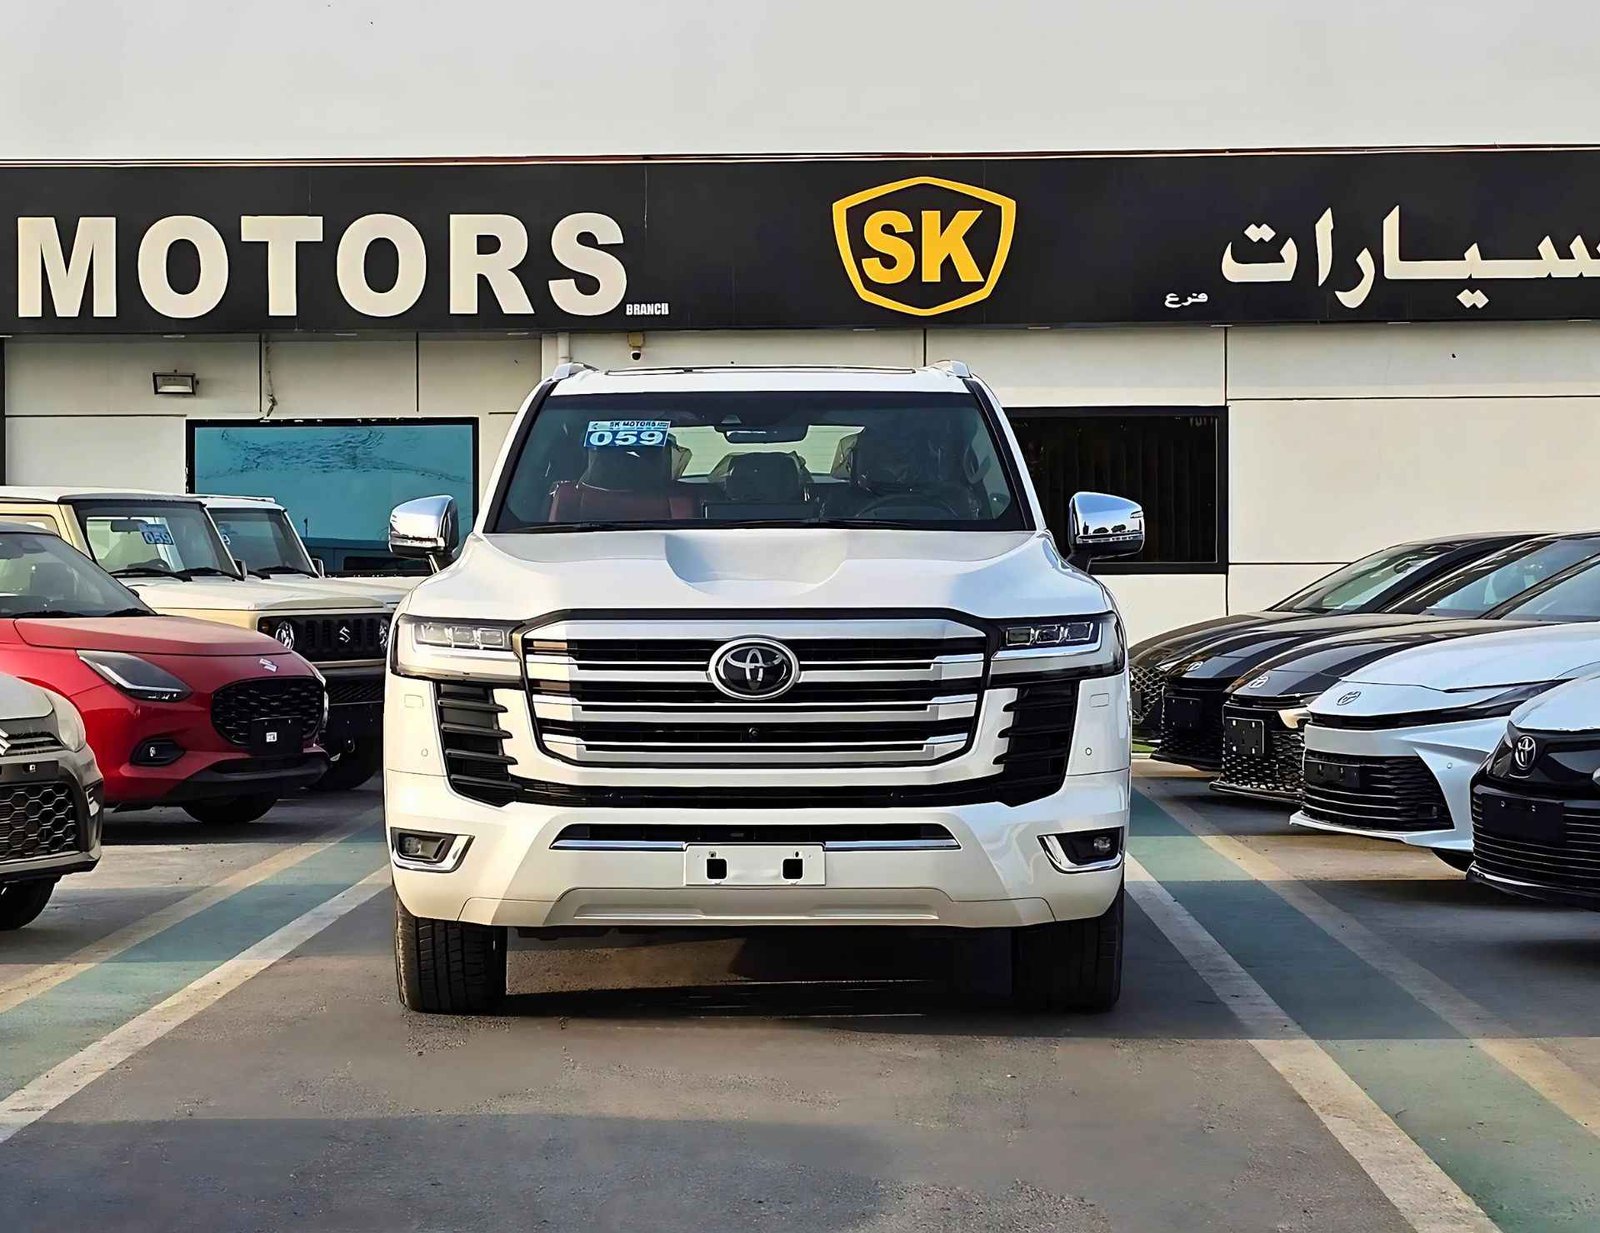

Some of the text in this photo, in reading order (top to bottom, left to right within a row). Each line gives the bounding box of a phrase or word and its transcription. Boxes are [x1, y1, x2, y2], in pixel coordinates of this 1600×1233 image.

[18, 212, 628, 319] MOTORS
[861, 210, 985, 284] SK
[589, 431, 664, 446] 059
